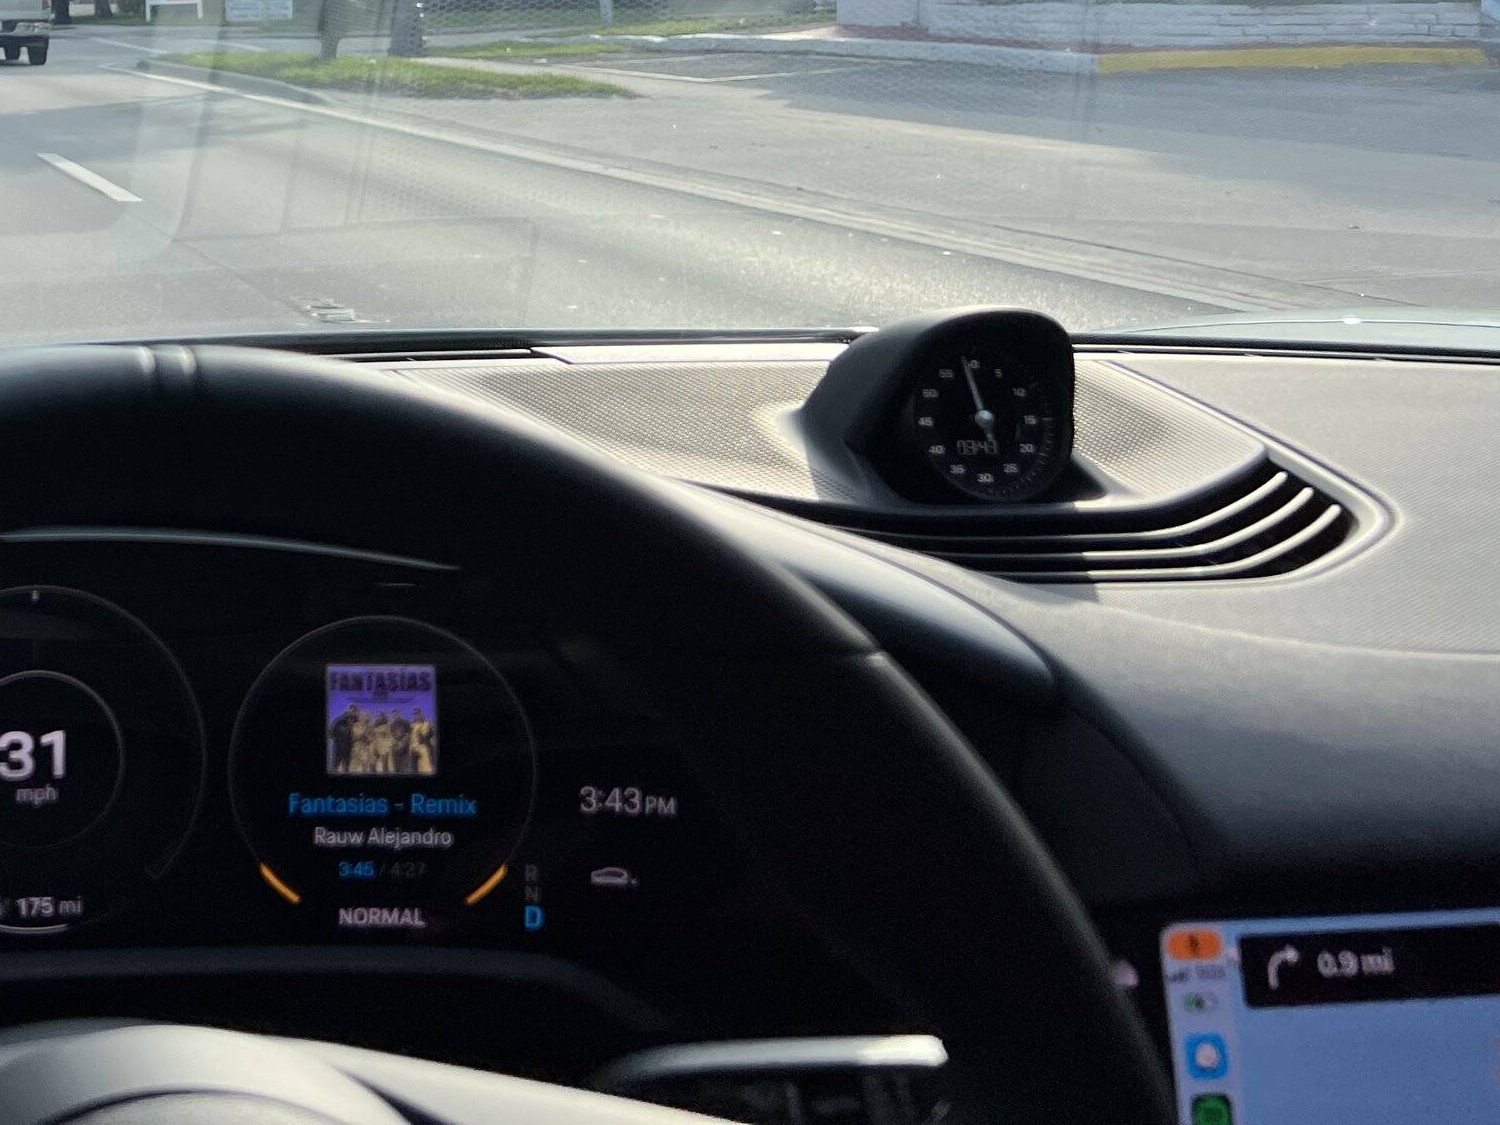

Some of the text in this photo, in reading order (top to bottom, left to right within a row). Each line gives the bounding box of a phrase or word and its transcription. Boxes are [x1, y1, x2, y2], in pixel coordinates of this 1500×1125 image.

[918, 416, 934, 427] 45
[1023, 415, 1037, 425] 15
[929, 444, 945, 454] 40
[1019, 443, 1034, 453] 20
[950, 464, 966, 474] 35
[1003, 463, 1018, 473] 25
[977, 473, 994, 483] 30
[15, 784, 59, 806] mph
[409, 793, 479, 817] Remix
[313, 827, 454, 851] Rauw Alejandro
[338, 860, 376, 878] 3:45
[16, 895, 84, 917] 175 mi
[338, 906, 426, 927] NORMAL
[524, 905, 544, 929] D
